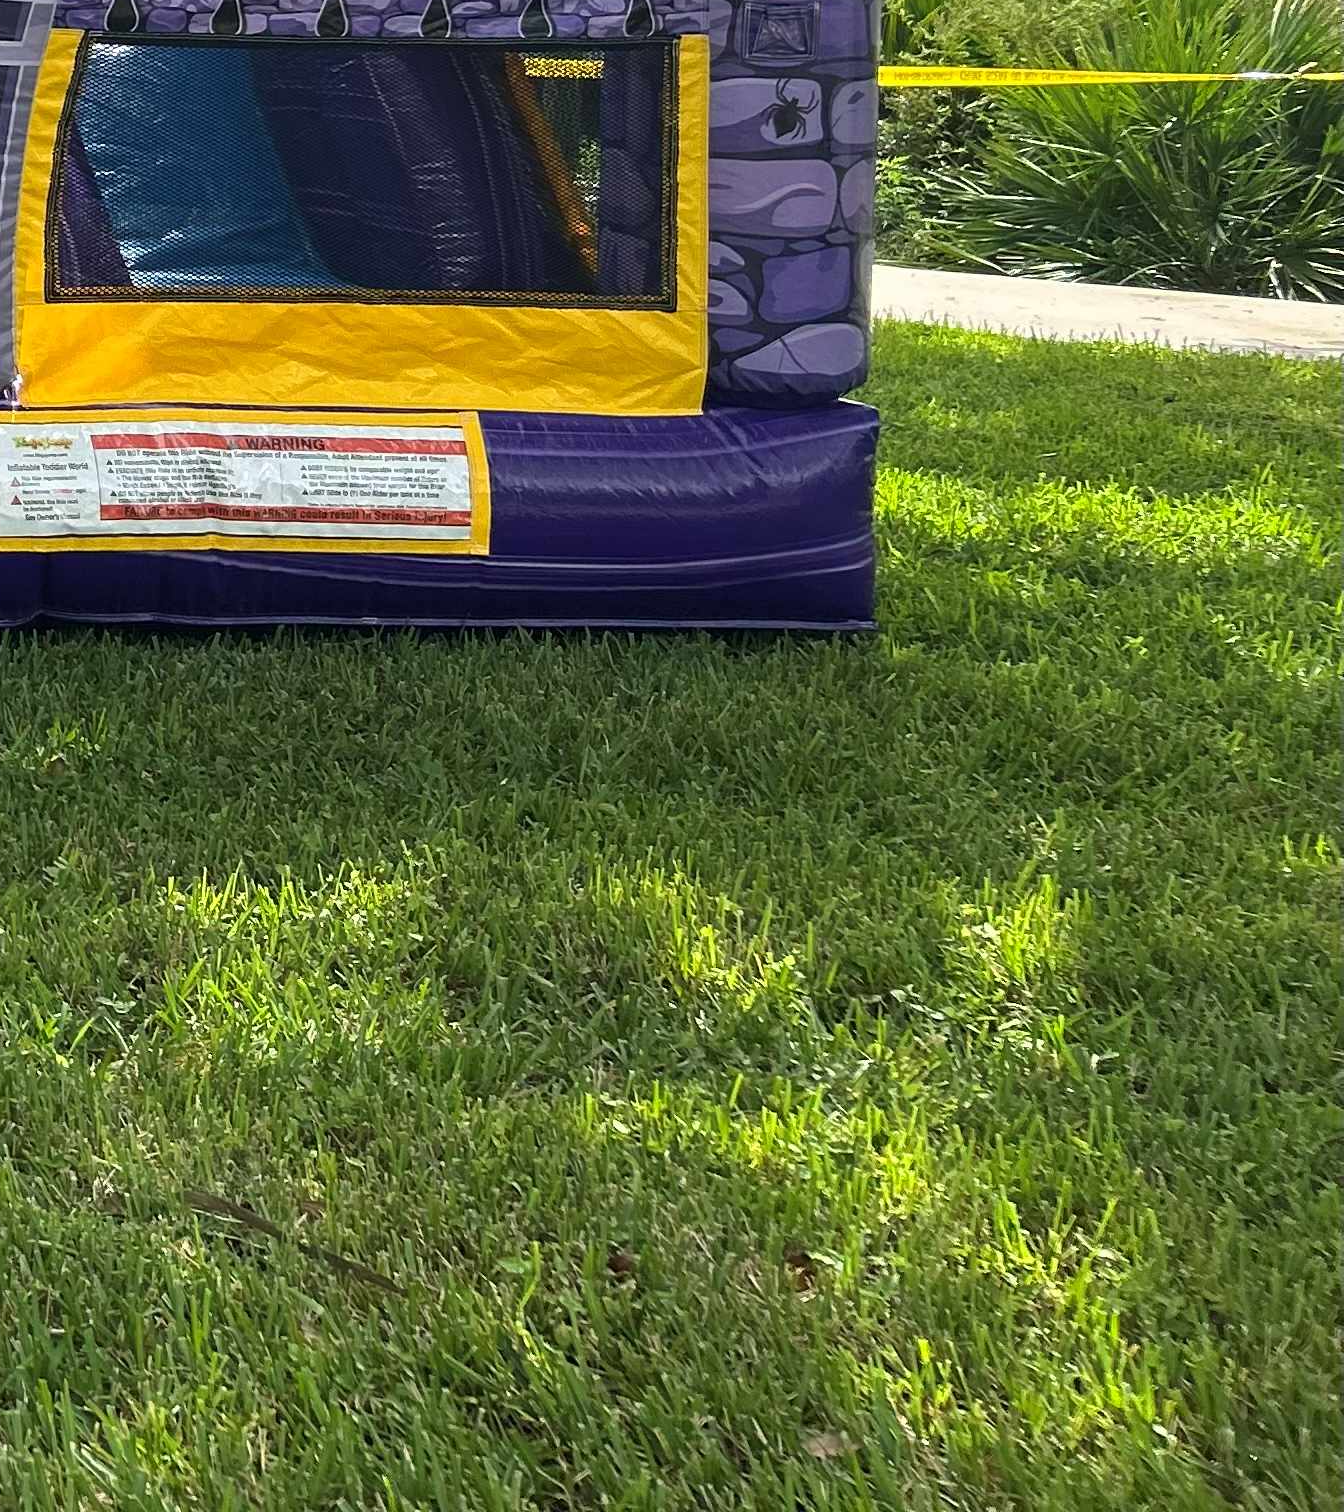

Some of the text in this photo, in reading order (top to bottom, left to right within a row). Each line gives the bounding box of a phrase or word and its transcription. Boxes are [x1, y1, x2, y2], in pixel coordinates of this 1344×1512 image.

[245, 438, 326, 451] WARNING
[207, 505, 229, 516] with
[231, 508, 250, 517] this
[300, 509, 328, 519] could
[330, 509, 359, 520] result
[362, 510, 371, 520] in
[374, 510, 412, 521] Serious
